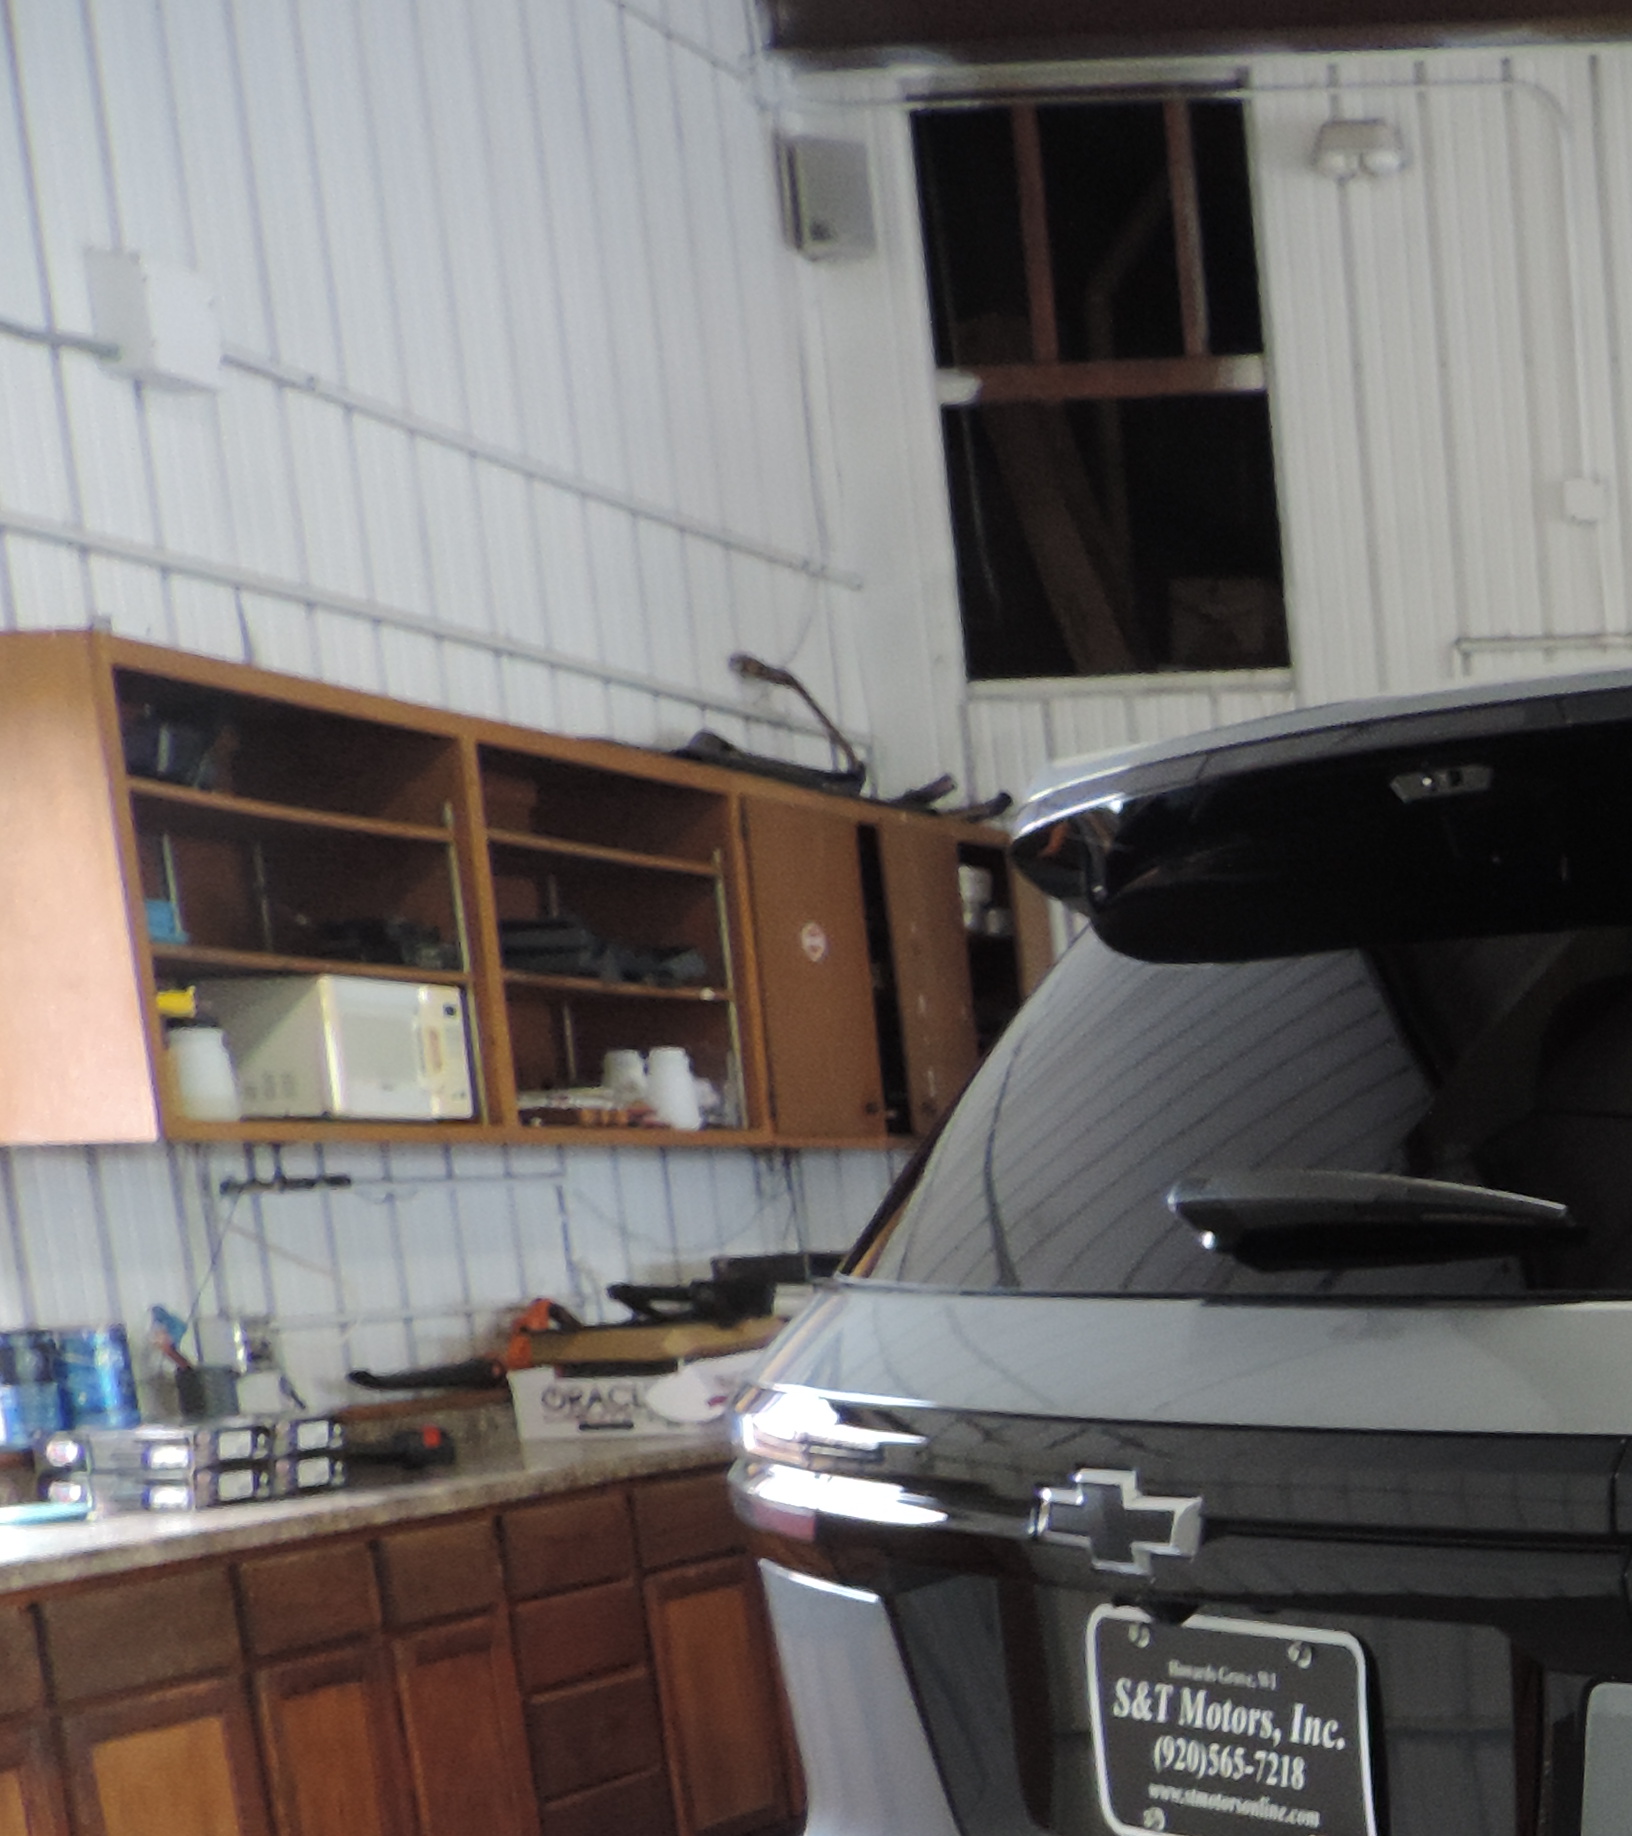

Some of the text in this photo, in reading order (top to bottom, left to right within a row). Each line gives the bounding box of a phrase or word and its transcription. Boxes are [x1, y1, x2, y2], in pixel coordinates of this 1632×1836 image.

[1112, 1676, 1346, 1751] S&T Motors, Inc.
[1153, 1735, 1307, 1790] (920)565-7218
